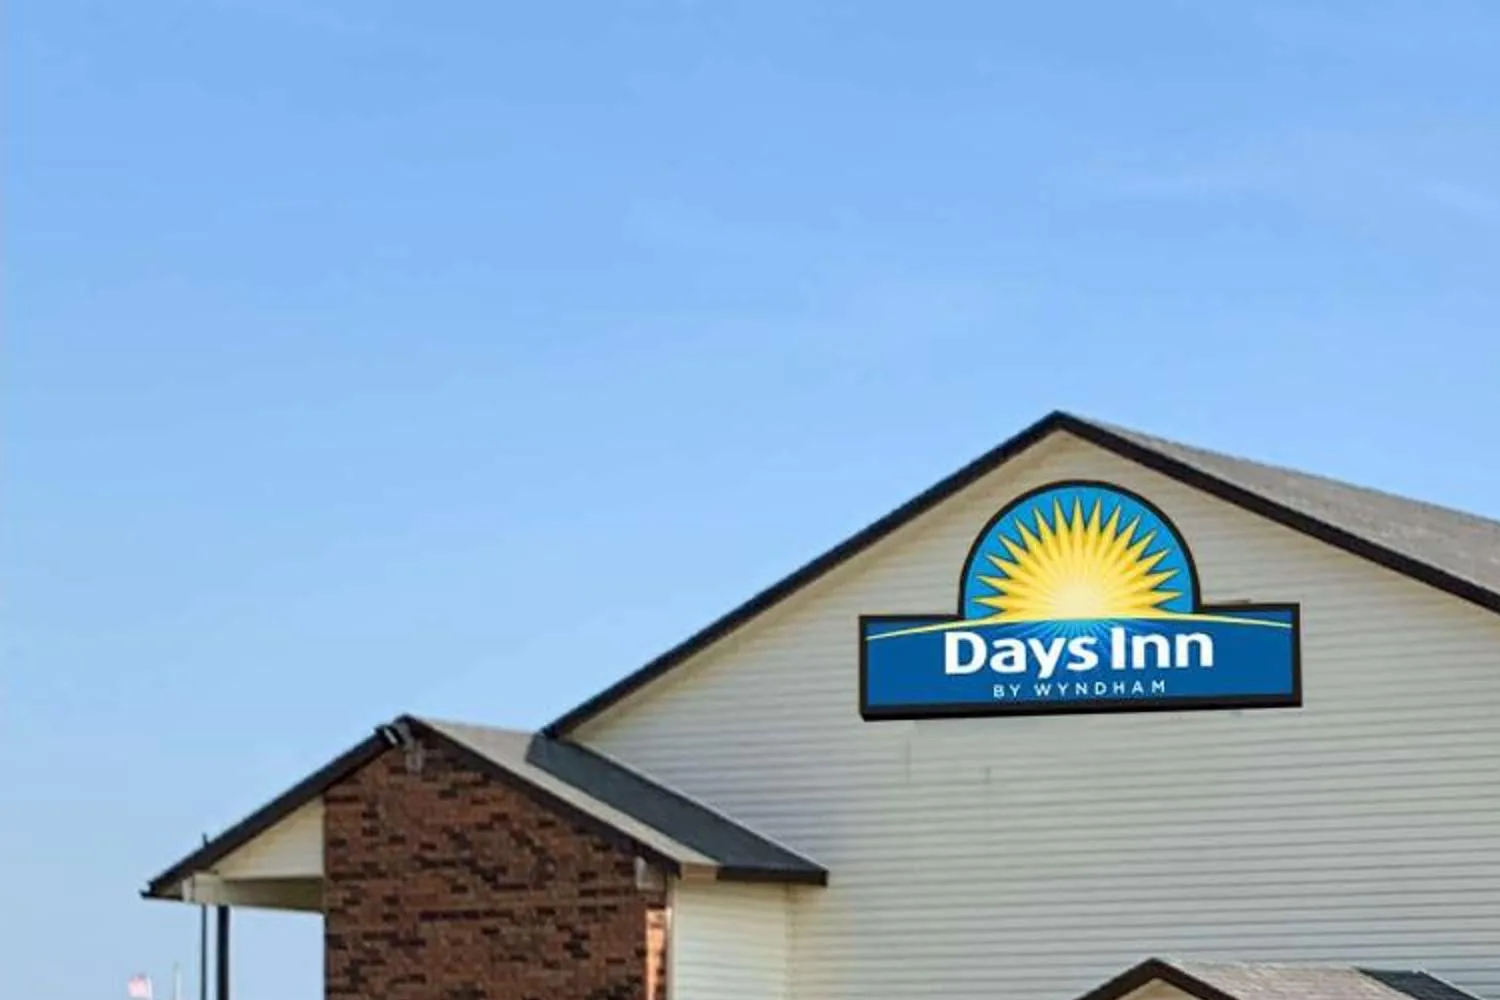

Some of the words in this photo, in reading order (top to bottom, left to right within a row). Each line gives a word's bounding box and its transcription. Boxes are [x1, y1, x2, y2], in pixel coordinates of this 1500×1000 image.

[945, 631, 1099, 679] Days
[1111, 627, 1214, 670] Inn
[993, 683, 1021, 698] BY
[1033, 679, 1166, 697] WYNDHAM
